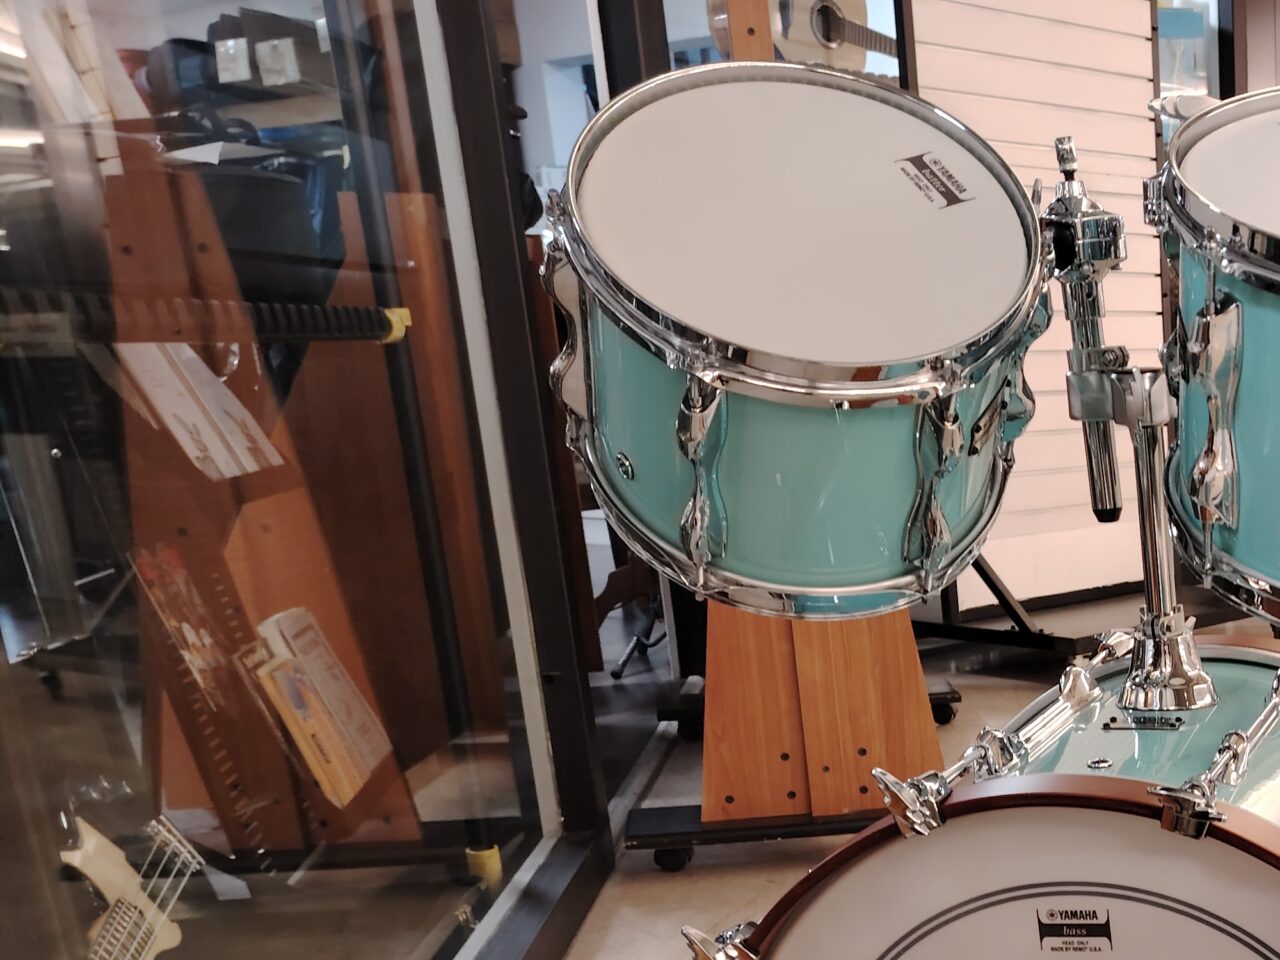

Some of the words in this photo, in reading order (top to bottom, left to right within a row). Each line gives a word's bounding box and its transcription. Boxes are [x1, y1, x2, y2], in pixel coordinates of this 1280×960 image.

[937, 165, 967, 194] YAMAHA
[1058, 910, 1098, 921] YAMAHA
[1063, 925, 1087, 936] bass
